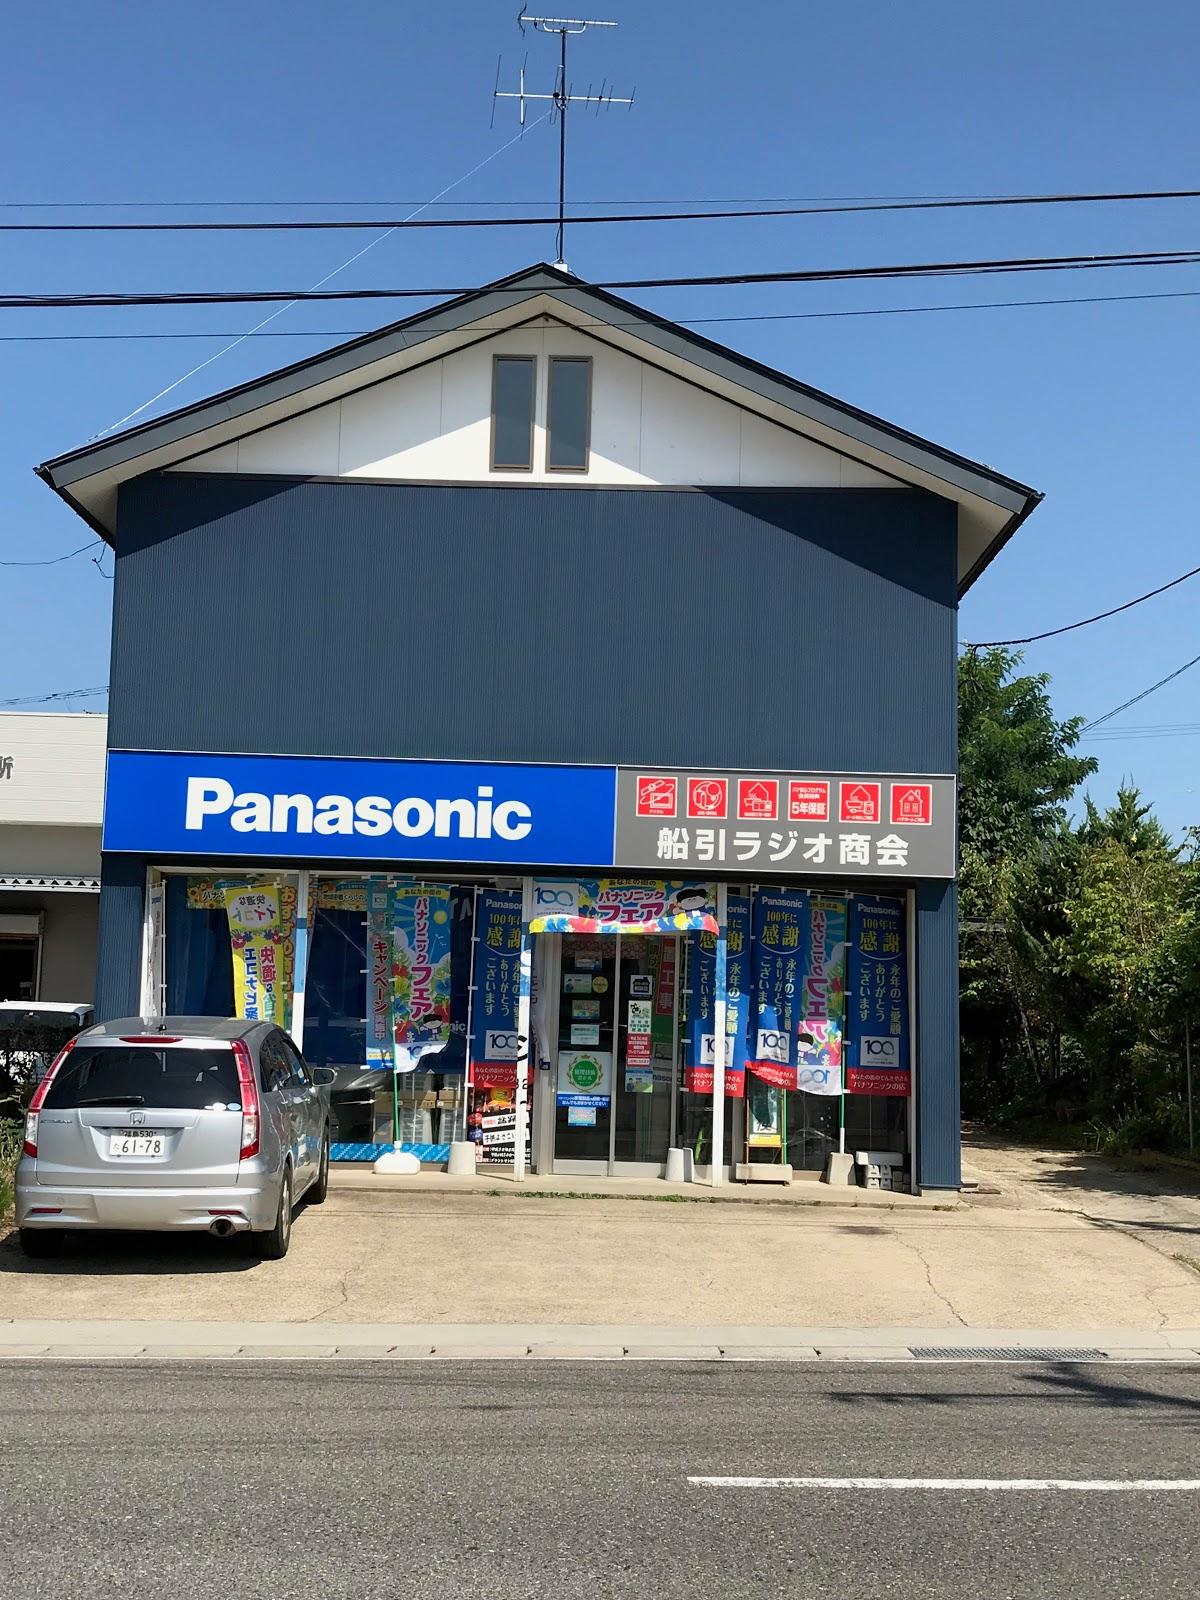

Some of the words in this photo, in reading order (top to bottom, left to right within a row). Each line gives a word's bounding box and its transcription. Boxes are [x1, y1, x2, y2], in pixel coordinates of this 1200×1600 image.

[185, 776, 533, 841] Panasonic
[791, 801, 826, 815] 5年保証
[656, 827, 909, 867] 船引ラジオ商会
[534, 887, 574, 907] 100
[597, 889, 665, 902] パナソニック
[761, 895, 803, 909] Panasonic
[598, 902, 665, 922] フェア
[766, 911, 798, 924] 100年に
[857, 903, 901, 916] Panasonic
[862, 917, 898, 931] 100年に
[761, 925, 800, 948] 感謝
[859, 930, 900, 953] 感謝
[485, 957, 498, 1016] ございます
[500, 958, 510, 1017] ありがとう
[700, 960, 709, 1020] ございます
[758, 955, 772, 1015] ございます
[773, 956, 784, 1017] ありがとう
[784, 958, 798, 1032] 永年のご愛顧
[859, 962, 871, 1022] ございます
[874, 962, 885, 1023] ありがとう
[889, 963, 902, 1036] 永年のご愛顧
[760, 1033, 788, 1049] 100
[864, 1039, 895, 1057] 100
[477, 1074, 518, 1083] パナソニック
[853, 1081, 907, 1091] パナソニックの店
[121, 1139, 161, 1154] 61-78
